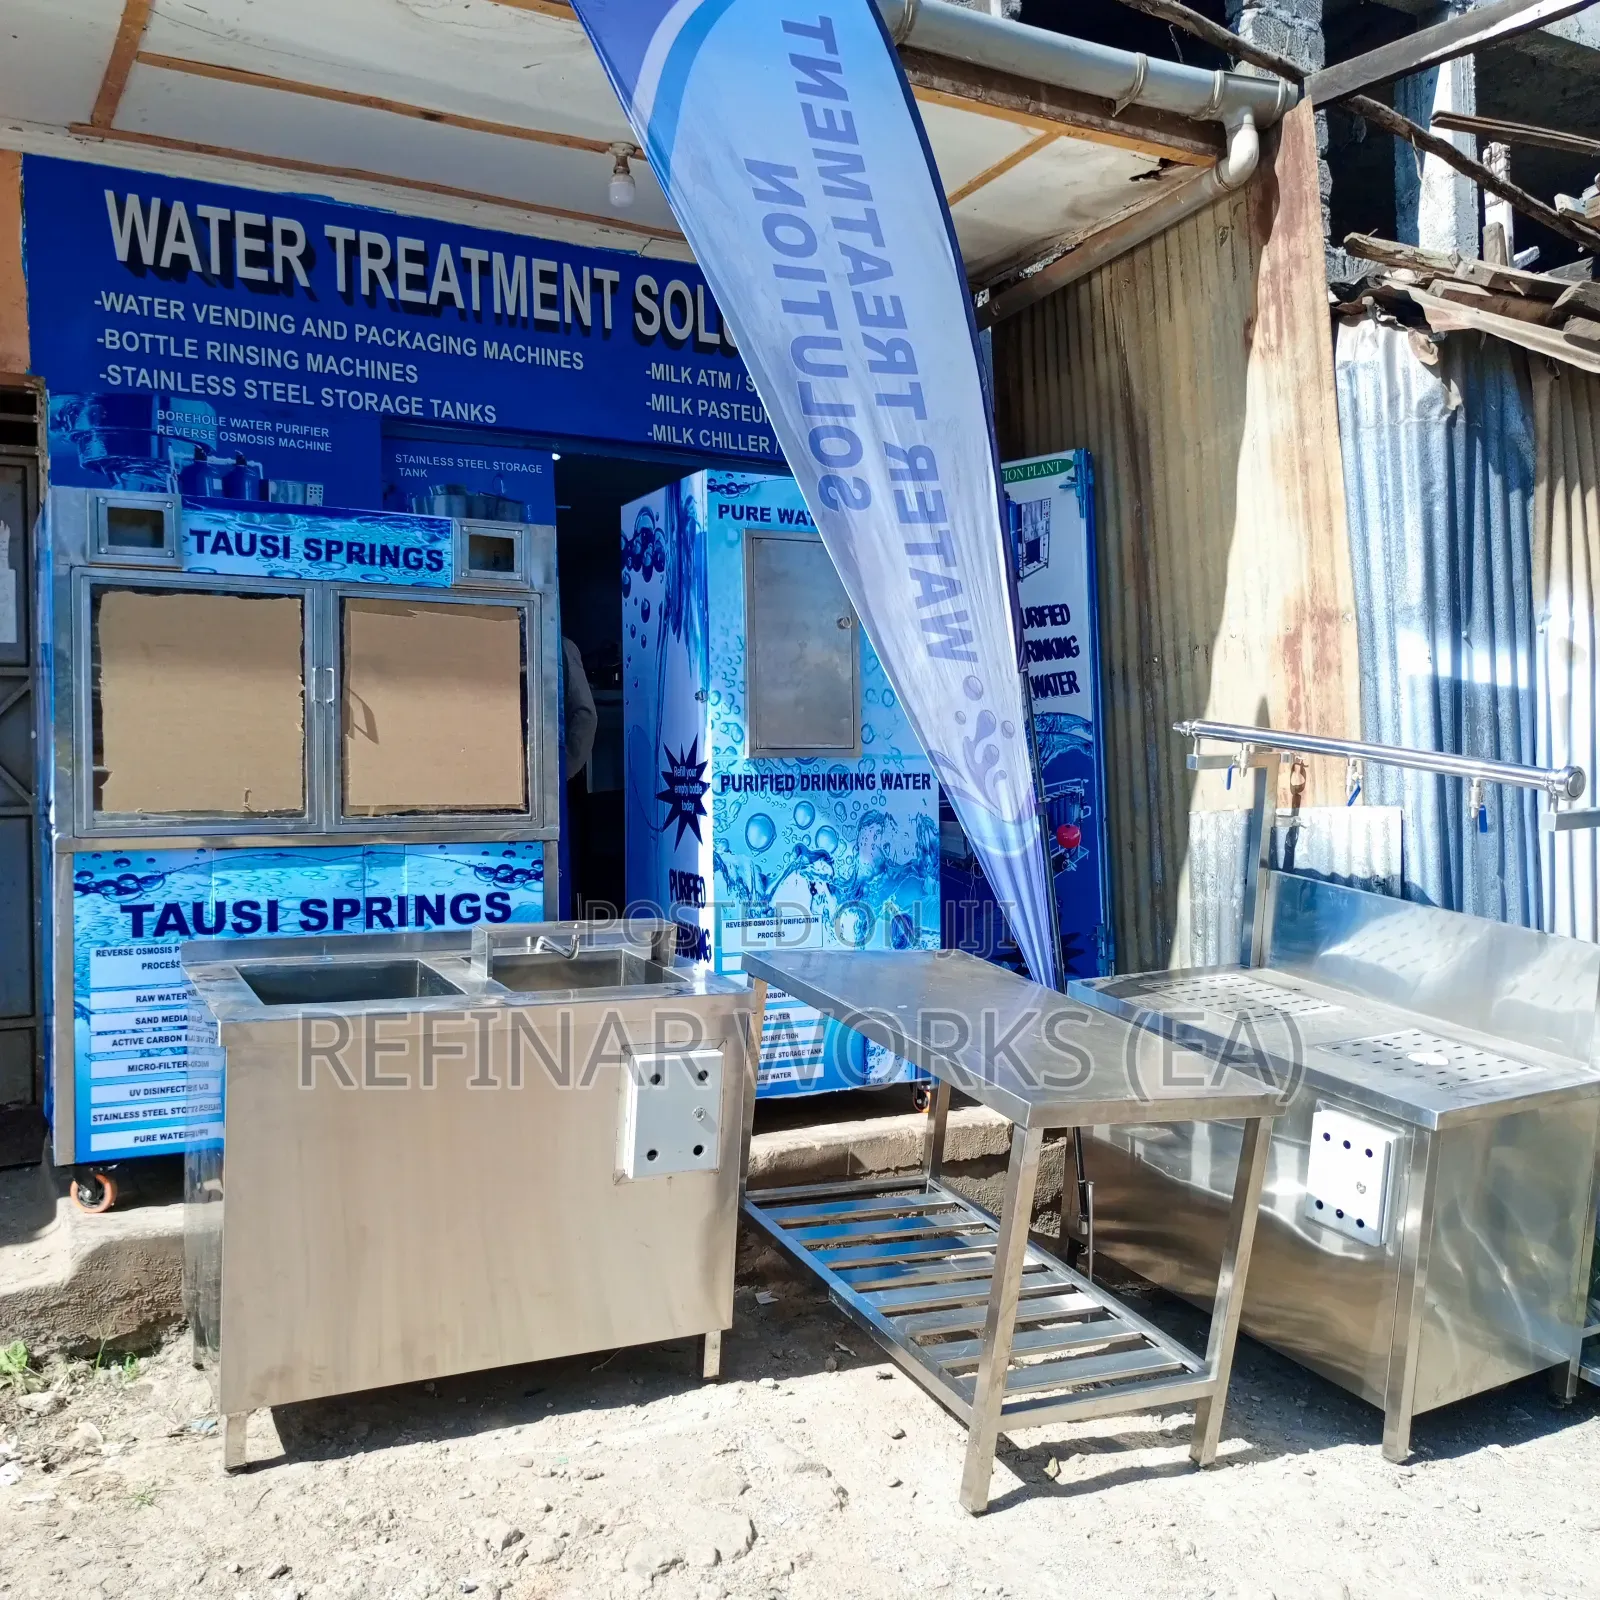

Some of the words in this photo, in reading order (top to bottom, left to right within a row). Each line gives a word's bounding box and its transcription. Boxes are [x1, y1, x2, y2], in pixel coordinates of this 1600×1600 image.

[104, 189, 311, 287] WATER
[324, 224, 619, 330] TREATMENT
[634, 274, 738, 348] SOL
[94, 290, 186, 321] -WATER
[193, 303, 295, 334] VENDING
[302, 317, 347, 341] AND
[355, 324, 477, 357] PACKAGING
[484, 341, 584, 371] MACHINES
[96, 328, 199, 360] -BOTTLE
[207, 341, 299, 370] RINSING
[306, 353, 418, 384] MACHINES
[646, 362, 693, 385] -MILK
[697, 369, 731, 390] ATM
[99, 364, 236, 397] -STAINLESS
[244, 378, 314, 406] STEEL
[321, 387, 424, 416] STORAGE
[430, 399, 497, 424] TANKS
[646, 393, 693, 416] -MILK
[157, 409, 226, 428] BOREHOLE
[230, 416, 272, 432] WATER
[275, 422, 330, 438] PURIFIER
[157, 424, 216, 442] REVERSE
[219, 431, 275, 447] OSMOSIS
[278, 437, 332, 453] MACHINE
[647, 424, 695, 445] -MILK
[700, 429, 771, 454] CHILLER
[395, 453, 454, 467] STAINLESS
[457, 458, 491, 470] STEEL
[492, 460, 543, 474] STORAGE
[398, 467, 428, 478] TANK
[1003, 467, 1026, 482] ION
[1027, 460, 1063, 478] PLANT
[718, 503, 772, 523] PURE
[189, 527, 291, 559] TAUSI
[303, 537, 444, 573] SPRINGS
[1029, 671, 1081, 698] WATER
[673, 766, 687, 777] Refill
[686, 768, 697, 781] your
[721, 773, 796, 793] PURIFIED
[800, 773, 876, 792] DRINKING
[880, 773, 931, 791] WATER
[681, 801, 695, 813] today
[120, 898, 279, 938] TAUSI
[299, 892, 512, 931] SPRINGS
[726, 920, 752, 929] REVERSE
[753, 919, 779, 927] OSMOSIS
[757, 931, 786, 939] PROCESS
[95, 948, 134, 957] REVERSE
[136, 946, 173, 955] OSMOSIS
[136, 994, 156, 1003] RAW
[158, 993, 188, 1002] WATER
[135, 1016, 158, 1025] SAND
[111, 1037, 144, 1047] ACTIVE
[146, 1035, 182, 1044] CARBON
[778, 1049, 805, 1058] STORAGE
[127, 1060, 188, 1072] MICRO-FILTER
[770, 1071, 792, 1080] WATER
[129, 1088, 141, 1097] UV
[92, 1110, 140, 1122] STAINLESS
[142, 1107, 169, 1118] STEEL
[133, 1134, 157, 1144] PURE
